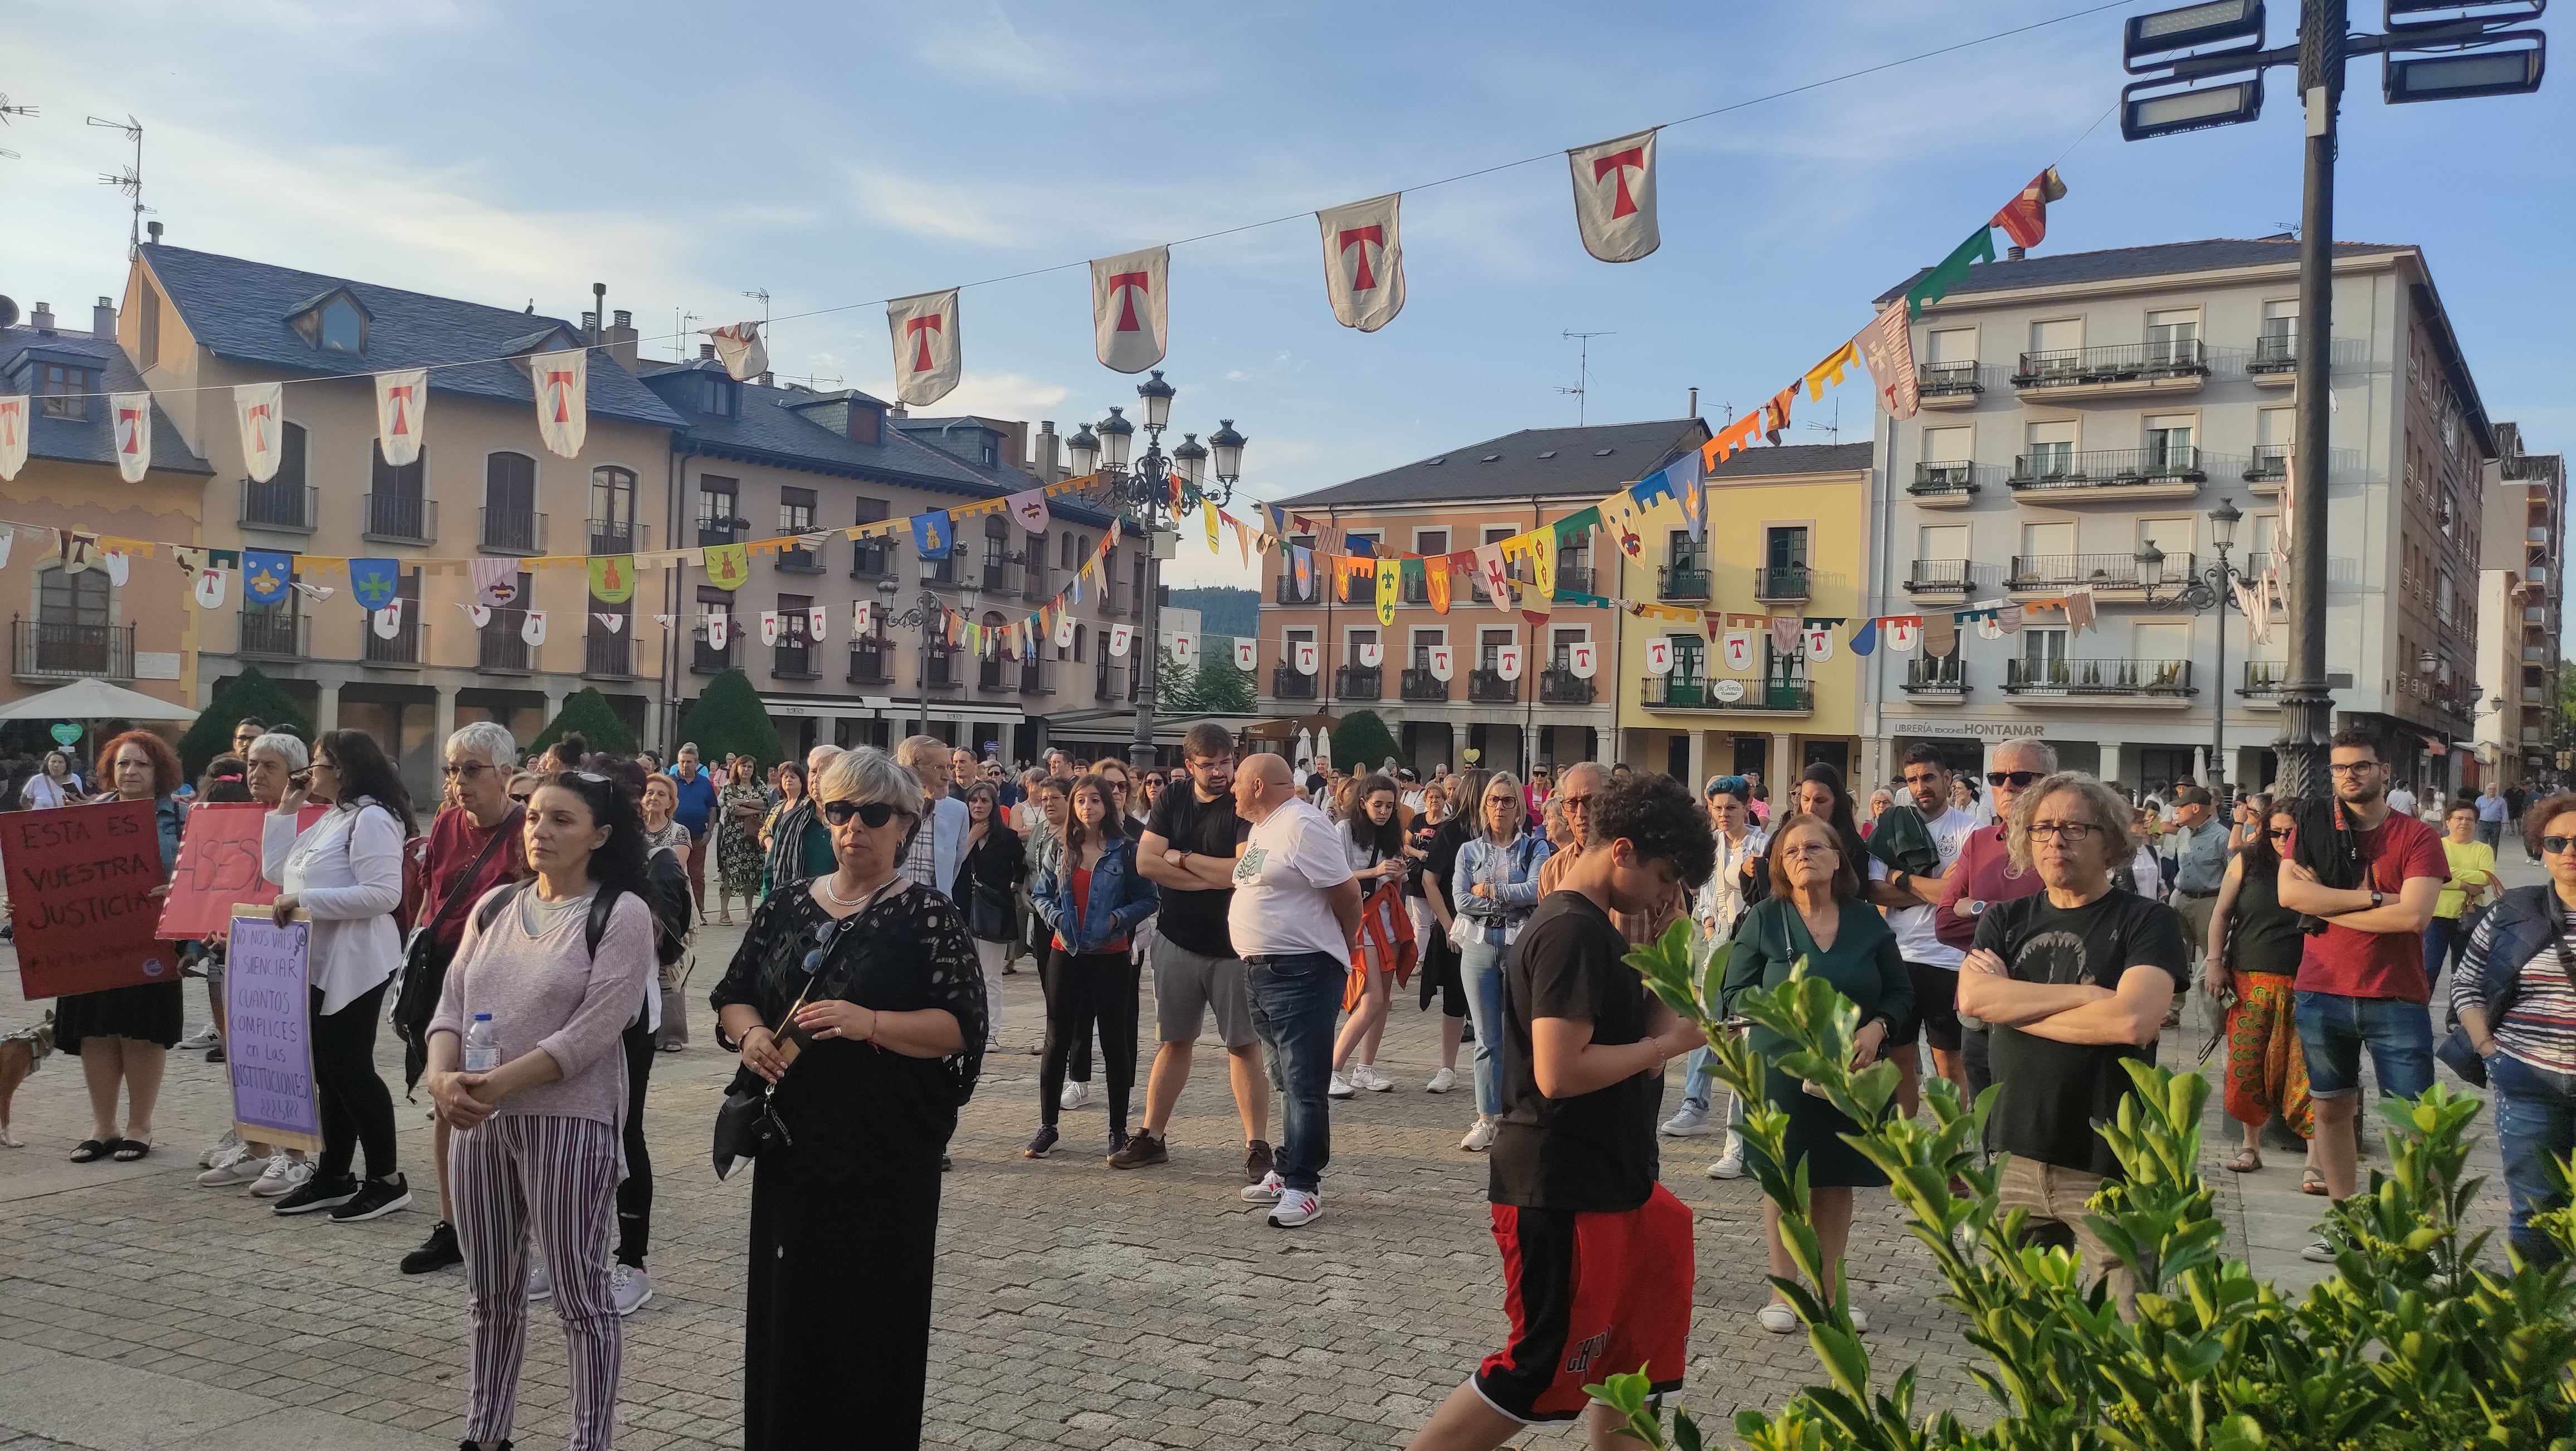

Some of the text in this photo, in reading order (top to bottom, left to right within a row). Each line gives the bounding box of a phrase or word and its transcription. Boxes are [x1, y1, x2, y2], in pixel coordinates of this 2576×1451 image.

[1895, 722, 1933, 733] LIBRERÍA
[1964, 724, 2045, 736] HONTANAR
[22, 815, 139, 849] ESTA ES
[22, 853, 150, 892] VUESTRA
[28, 891, 152, 930] JUSTICIA
[235, 928, 292, 951] NO NOS VAIS
[232, 956, 237, 971] A
[231, 1014, 297, 1042] COMPLICES
[246, 1044, 259, 1058] en
[231, 1062, 309, 1099] INSTITUCIONES
